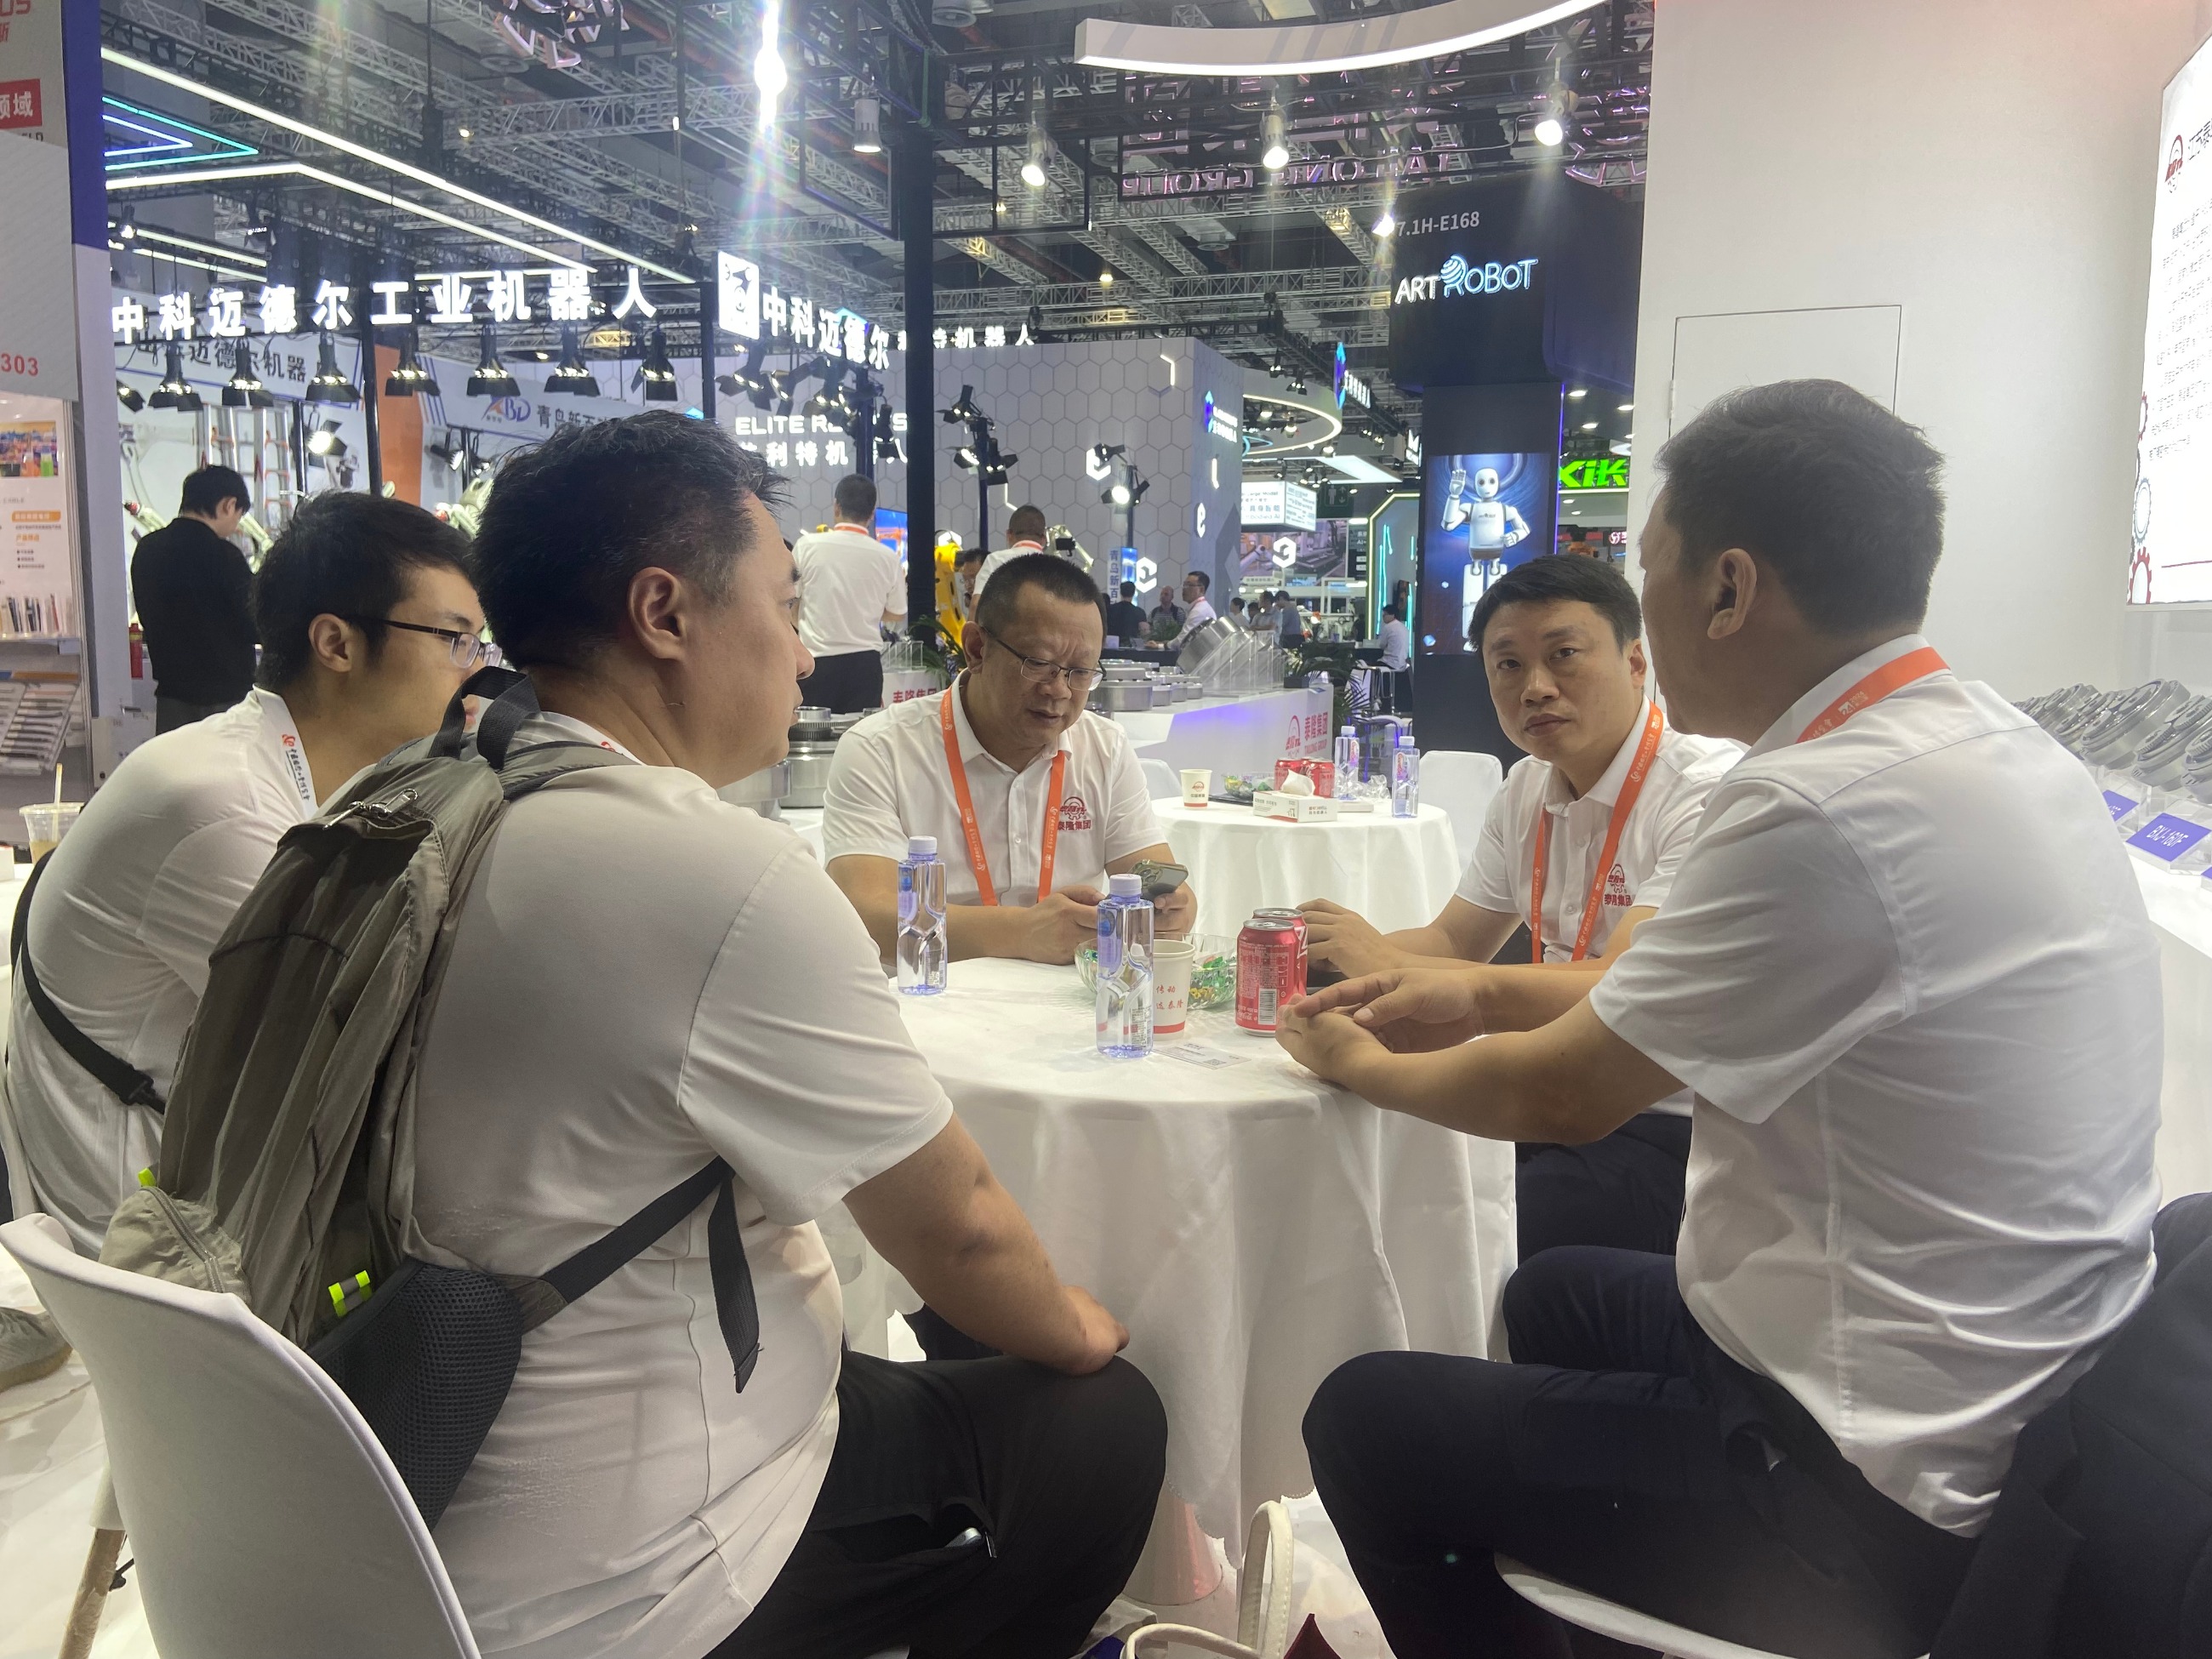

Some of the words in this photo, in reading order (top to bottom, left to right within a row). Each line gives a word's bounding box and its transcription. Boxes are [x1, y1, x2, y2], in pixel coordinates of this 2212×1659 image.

[1398, 211, 1479, 237] 7.1H-E168
[1394, 275, 1440, 305] ART
[111, 265, 658, 345] 中科迈德尔工业机器人
[762, 286, 891, 369] 中科迈德尔
[736, 415, 805, 436] ELITE
[1058, 819, 1092, 831] 泰隆集团
[1156, 983, 1176, 995] 传动
